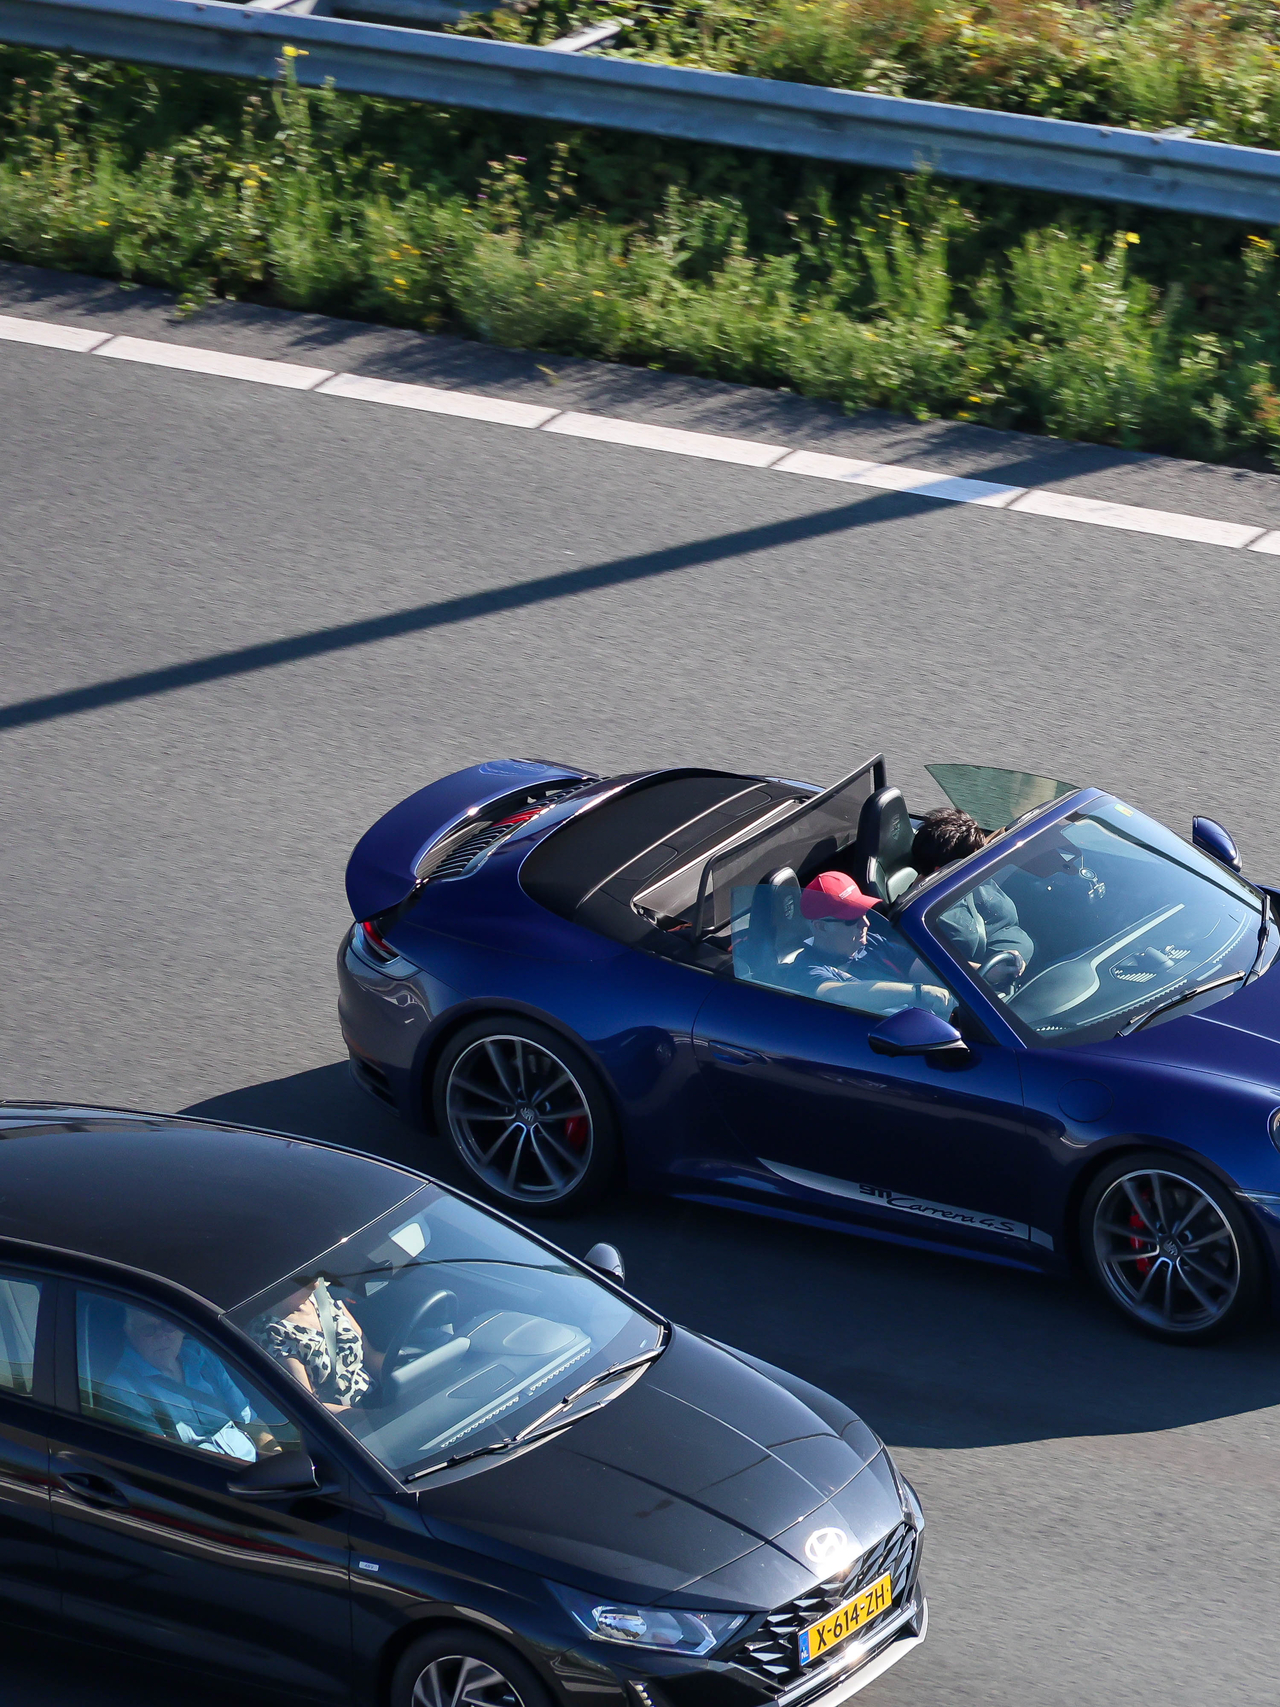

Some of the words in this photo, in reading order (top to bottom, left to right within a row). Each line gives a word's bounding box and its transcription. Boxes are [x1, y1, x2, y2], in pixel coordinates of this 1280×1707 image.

[859, 1183, 893, 1199] 911
[886, 1197, 977, 1224] Carrera
[979, 1217, 1015, 1233] 4S
[816, 1583, 885, 1652] X-614-ZH
[801, 1650, 809, 1660] NL
